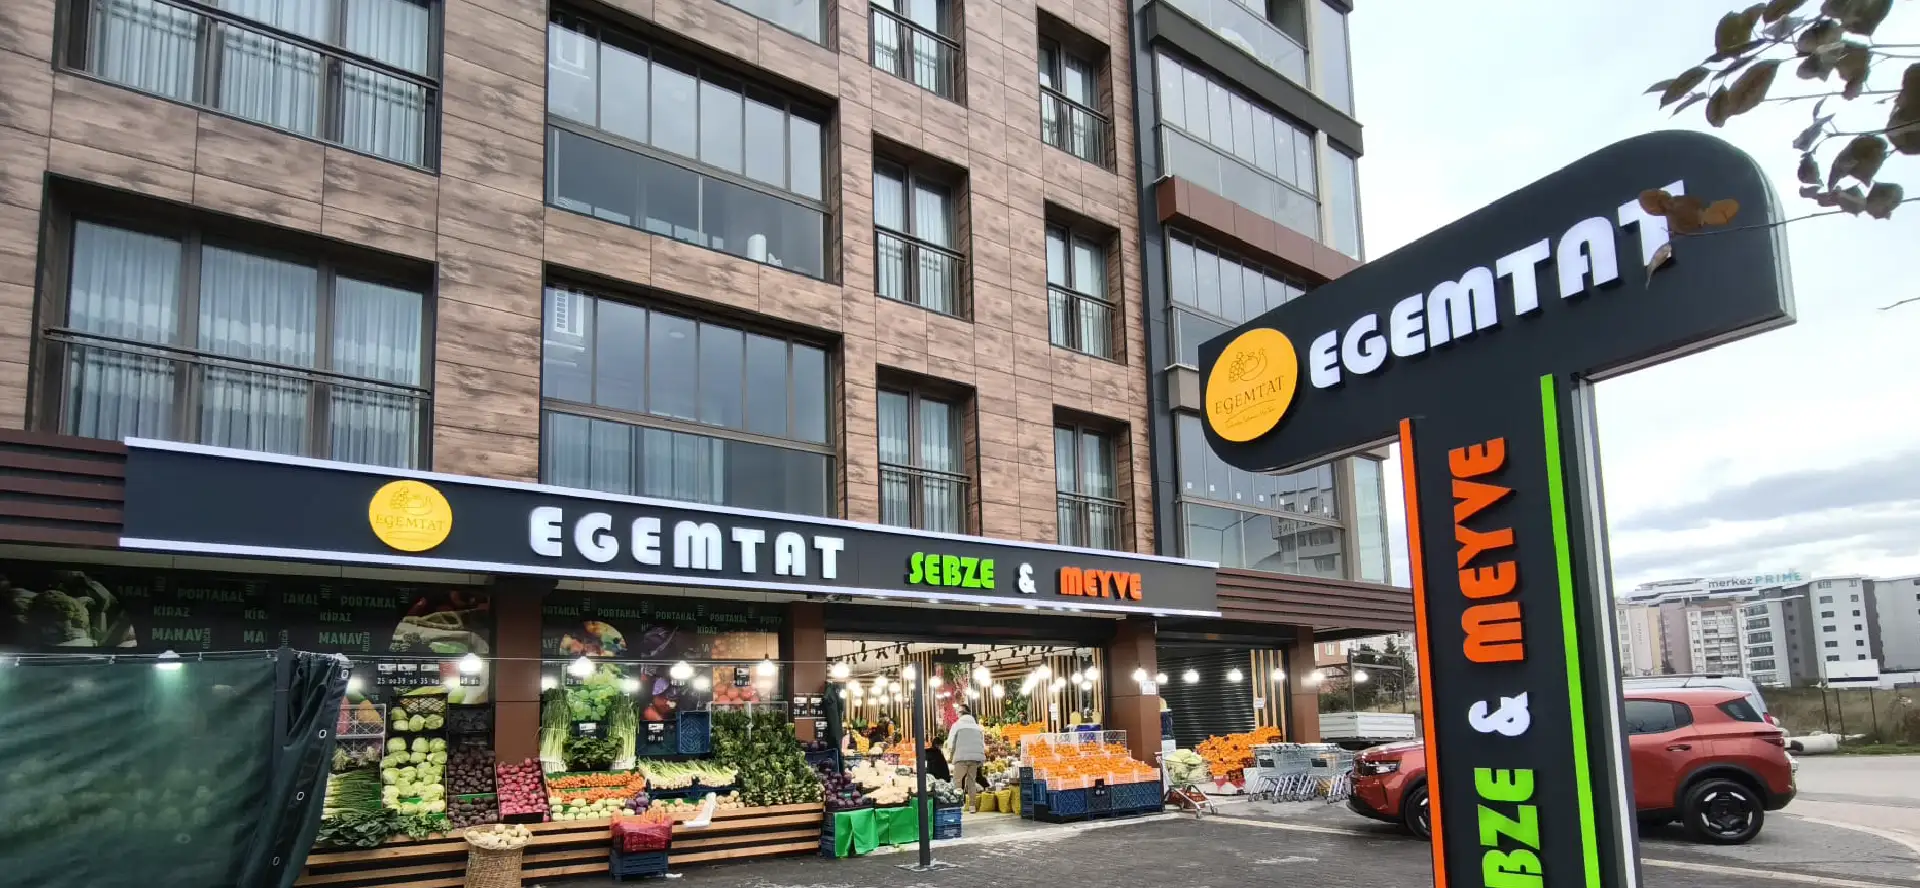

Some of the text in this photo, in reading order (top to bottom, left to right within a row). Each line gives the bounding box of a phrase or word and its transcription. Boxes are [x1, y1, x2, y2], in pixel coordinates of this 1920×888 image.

[1309, 179, 1685, 389] EGEMTAT
[1215, 375, 1285, 415] EGEMTAT
[375, 514, 445, 531] EGEMTAT
[528, 506, 845, 579] EGEMTAT
[1448, 437, 1524, 664] MEYVE
[909, 551, 1143, 600] SEBZE & MEYVE
[151, 627, 203, 642] MANAV
[318, 631, 364, 645] MANAV
[1467, 691, 1532, 737] &
